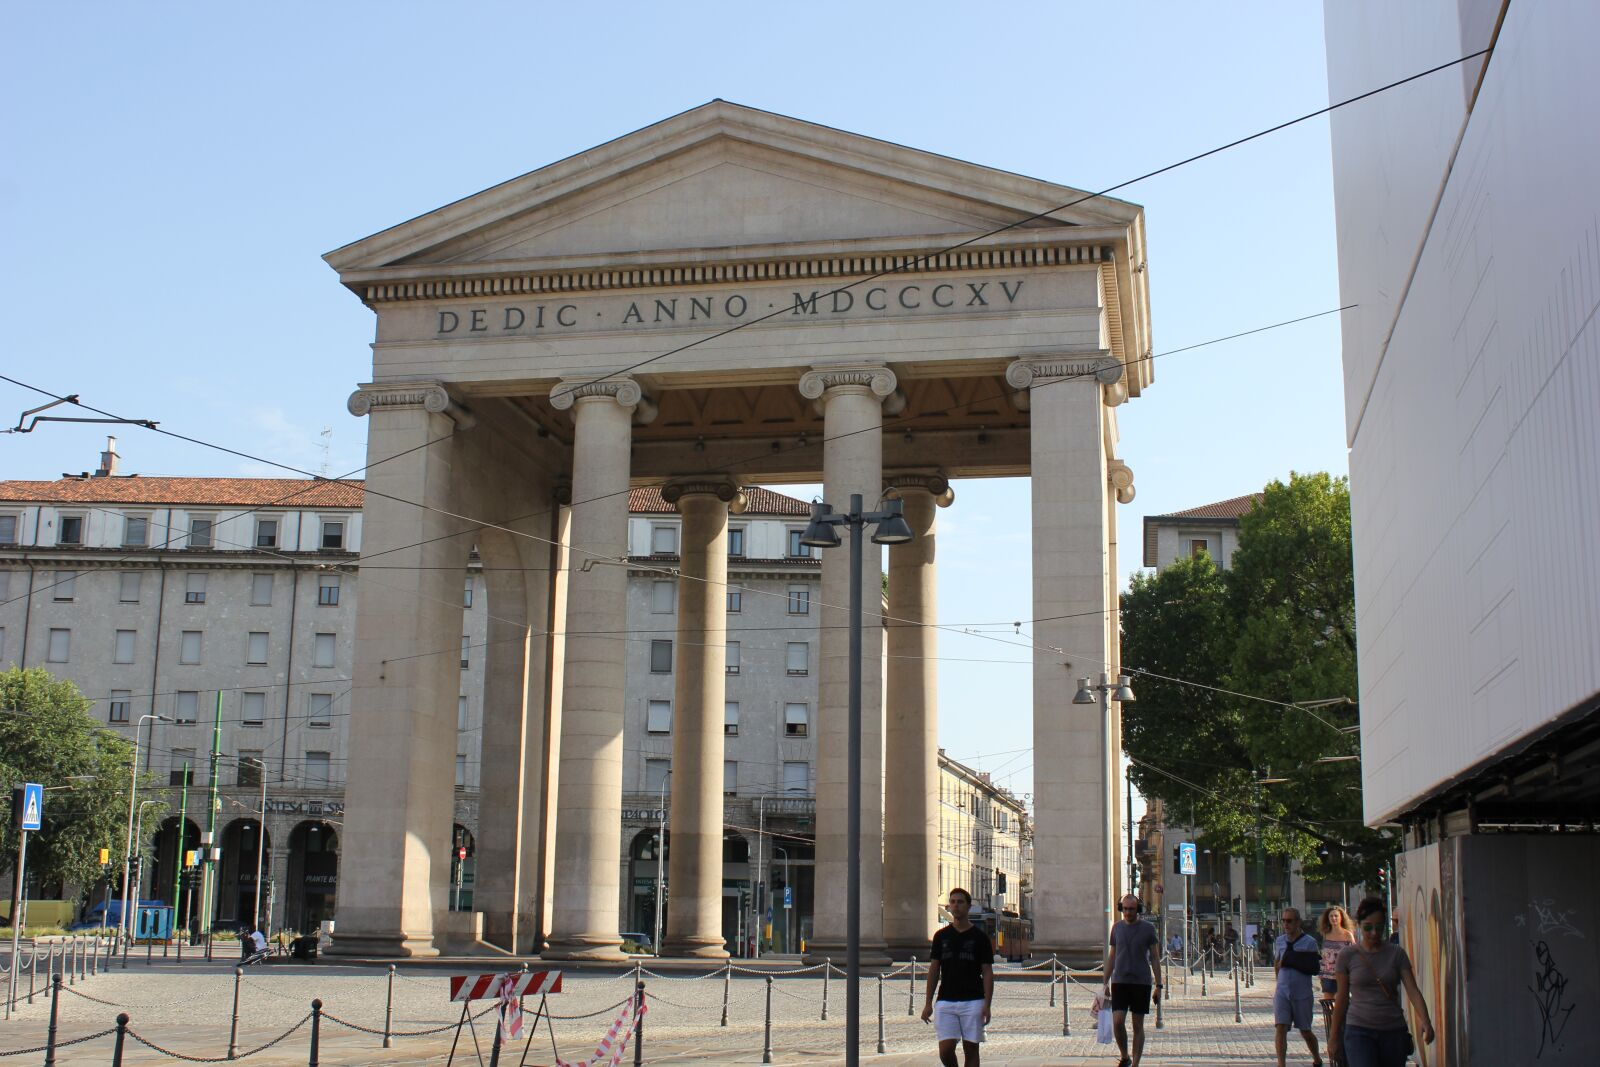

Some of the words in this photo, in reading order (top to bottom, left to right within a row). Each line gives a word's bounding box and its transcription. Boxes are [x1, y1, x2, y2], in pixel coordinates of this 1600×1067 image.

[438, 306, 578, 335] DEDIC
[622, 295, 749, 324] ANNO
[792, 281, 1023, 315] MDCCCXV
